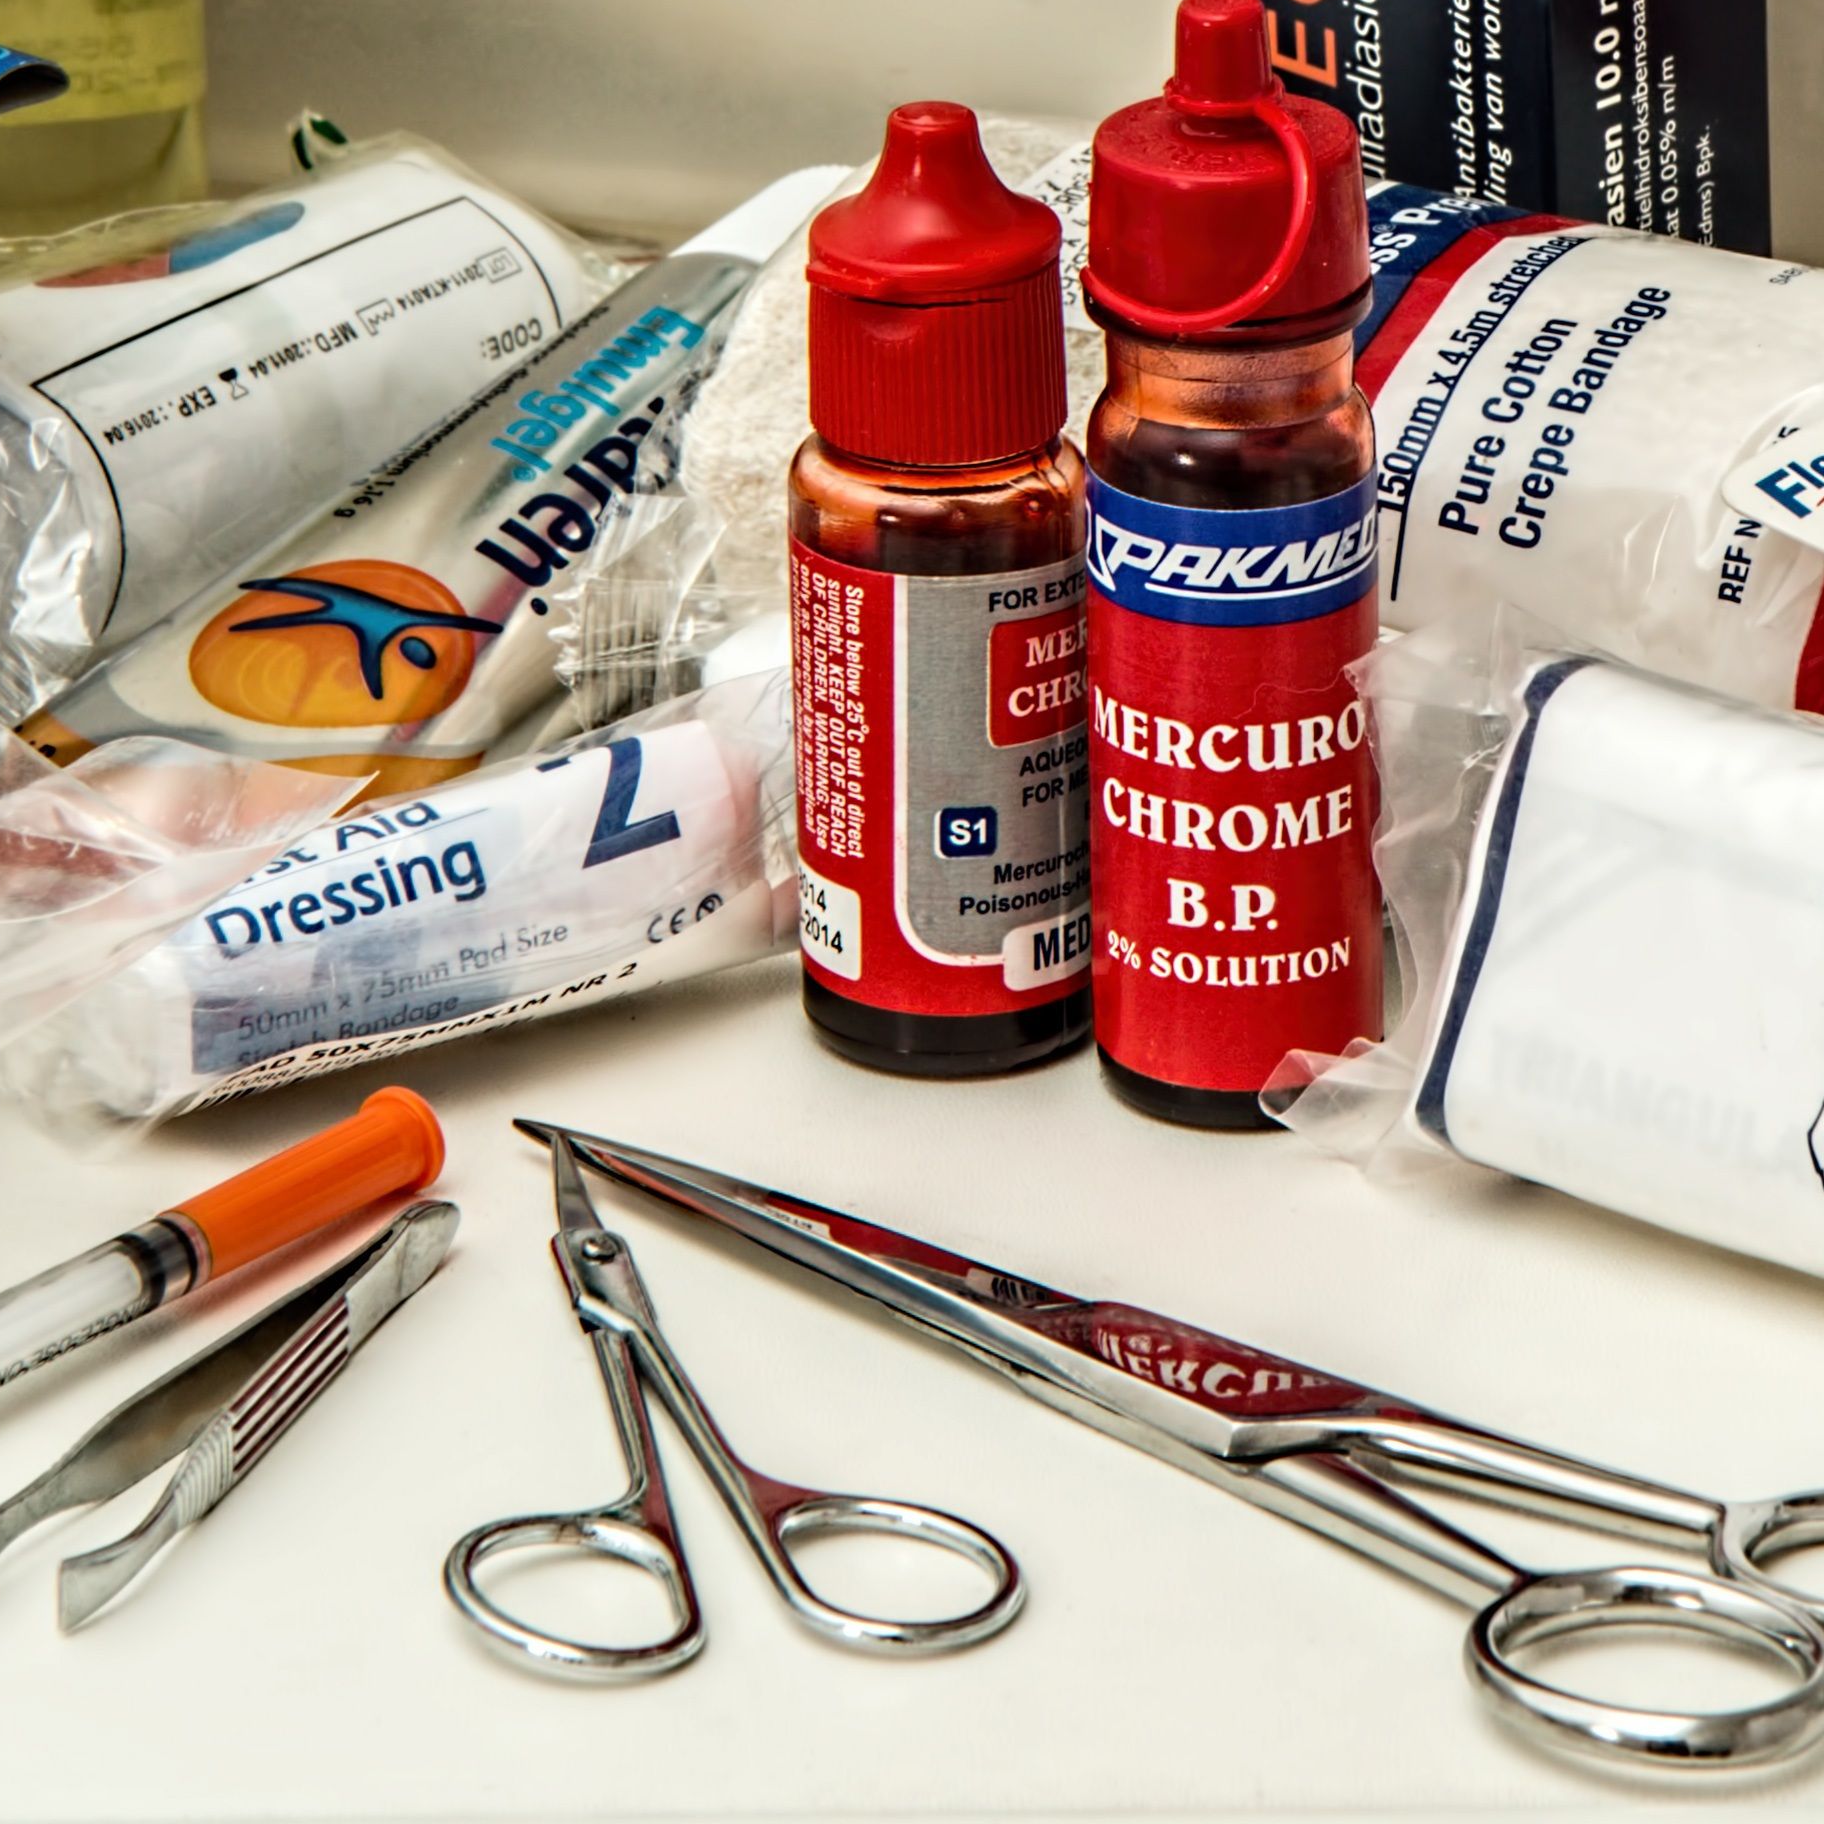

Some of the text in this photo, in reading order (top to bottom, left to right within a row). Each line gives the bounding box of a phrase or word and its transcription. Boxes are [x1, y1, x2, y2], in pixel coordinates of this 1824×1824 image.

[1593, 25, 1623, 112] 10.0
[1657, 55, 1676, 116] m/m
[1486, 72, 1505, 132] van
[1658, 119, 1679, 204] 0.05%
[1695, 123, 1717, 180] Bpk.
[479, 317, 544, 361] CODE:
[1375, 306, 1503, 514] 150mm x 4.5m
[1438, 315, 1580, 538] Pure Cotton
[1498, 283, 1673, 551] Crepe Bandage
[988, 587, 1038, 614] FOR
[1717, 542, 1755, 605] REF
[845, 584, 865, 635] Store
[845, 638, 865, 696] below
[812, 571, 830, 851] OF CHILDREN. WARNING: Use
[827, 578, 848, 858] sunlight. KEEP OUT OF REACH
[1091, 682, 1366, 774] MERCURO
[846, 746, 865, 775] out
[846, 776, 866, 802] of
[1021, 776, 1066, 809] FOR
[1100, 776, 1354, 853] CHROME
[334, 800, 442, 853] Aid
[846, 803, 866, 859] direct
[947, 816, 990, 847] S1
[204, 839, 487, 960] Dressing
[1164, 877, 1280, 933] B.P.
[236, 1000, 329, 1043] 50mm
[458, 939, 508, 973] Pad
[516, 922, 570, 952] Size
[560, 973, 611, 999] NR
[615, 960, 640, 979] 2
[1106, 928, 1352, 988] 2% SOLUTION
